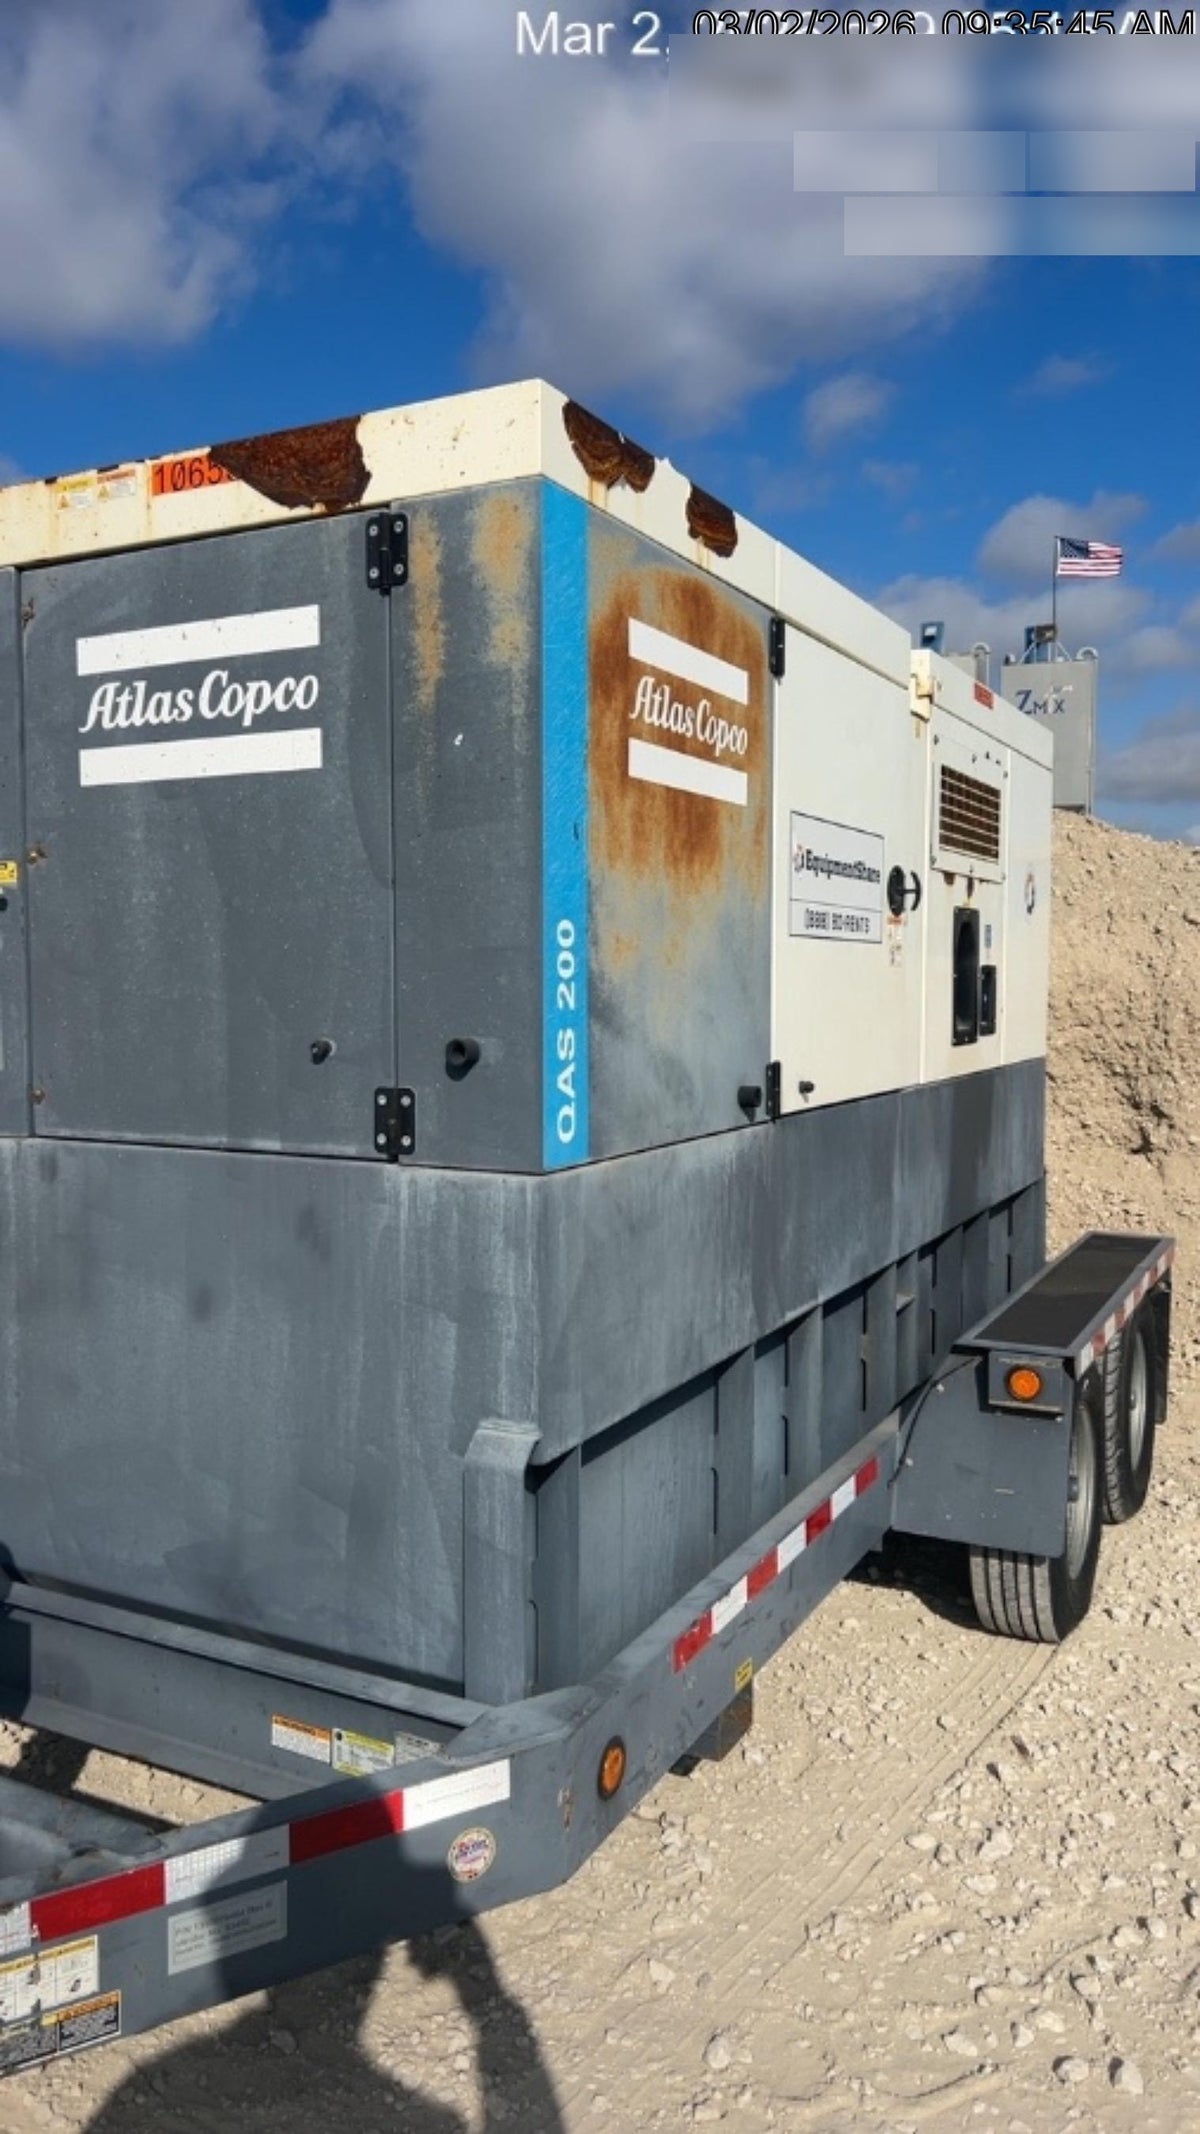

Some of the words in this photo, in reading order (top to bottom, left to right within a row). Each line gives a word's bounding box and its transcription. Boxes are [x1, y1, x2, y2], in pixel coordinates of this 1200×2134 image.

[155, 457, 233, 494] 1065
[79, 680, 194, 733] Atlas
[199, 669, 320, 727] Copco
[629, 675, 695, 740] Atlas
[696, 698, 749, 757] Copco
[805, 848, 881, 884] EquipmentShare
[556, 918, 576, 1011] 200
[556, 1028, 577, 1144] QAS
